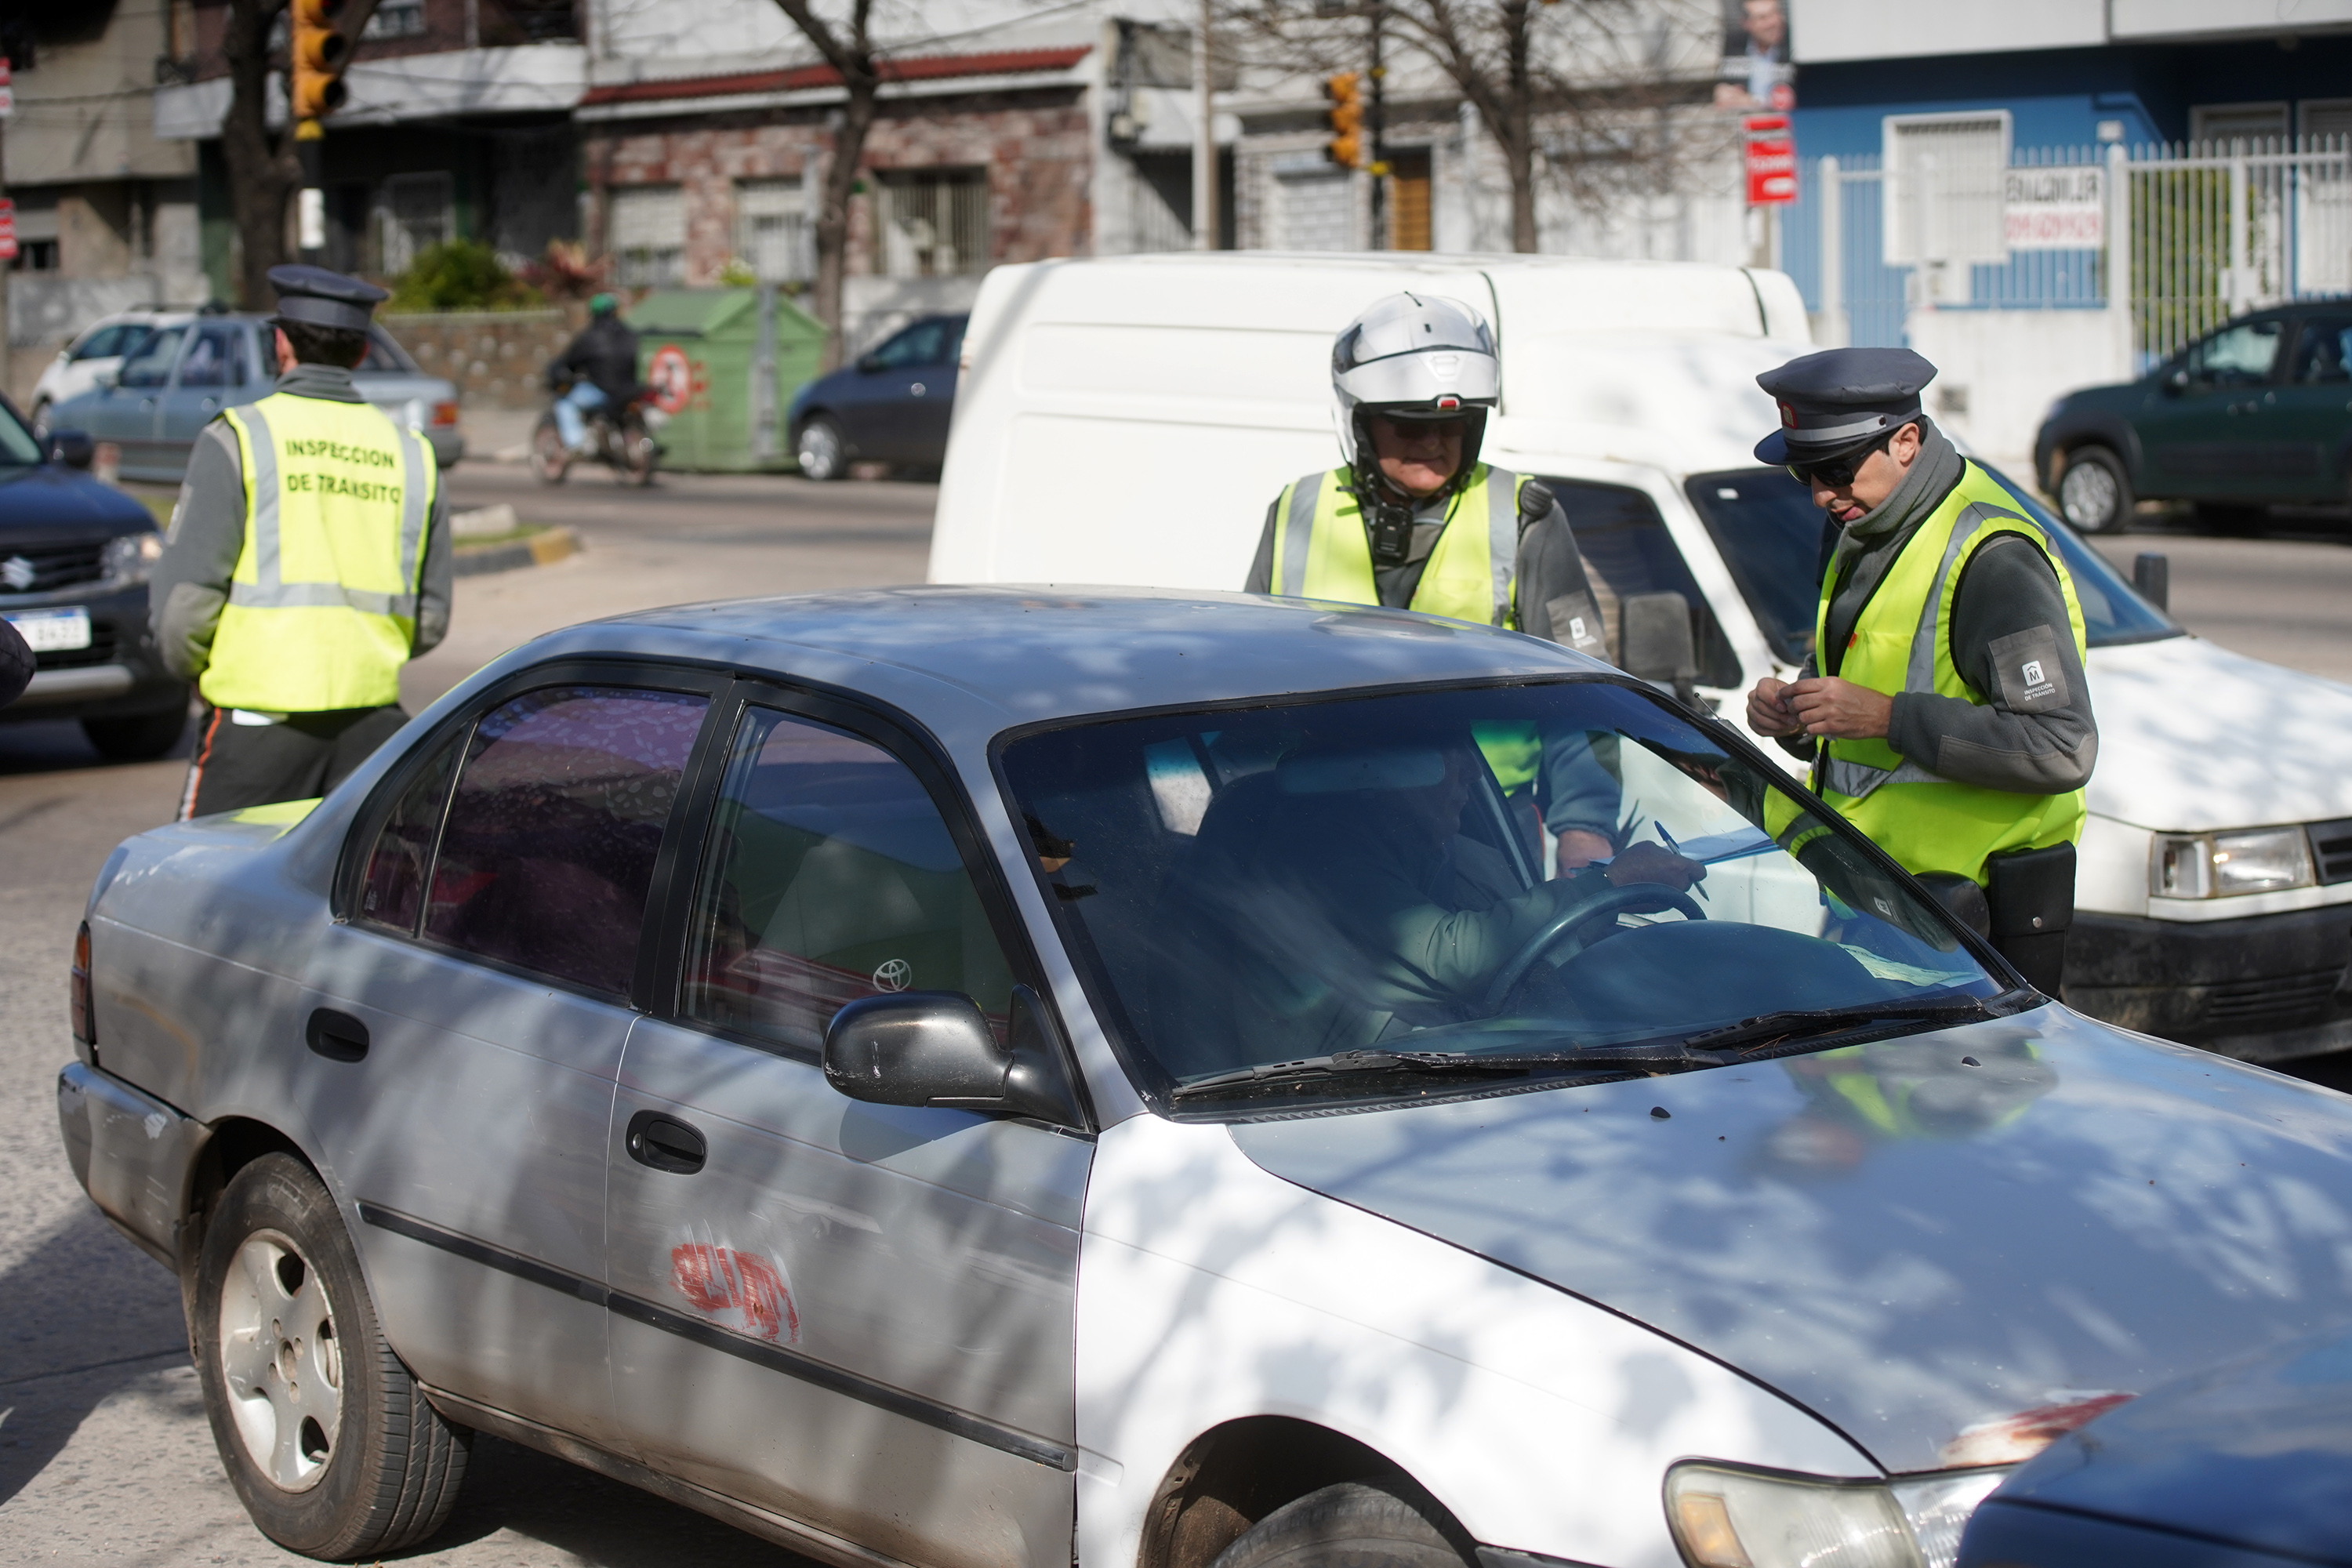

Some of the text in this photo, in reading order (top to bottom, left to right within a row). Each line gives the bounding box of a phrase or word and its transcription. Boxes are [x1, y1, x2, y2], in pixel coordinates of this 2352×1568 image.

[286, 441, 394, 467] INSPECCION
[287, 474, 401, 503] DE TRANSITO
[2028, 670, 2040, 682] M
